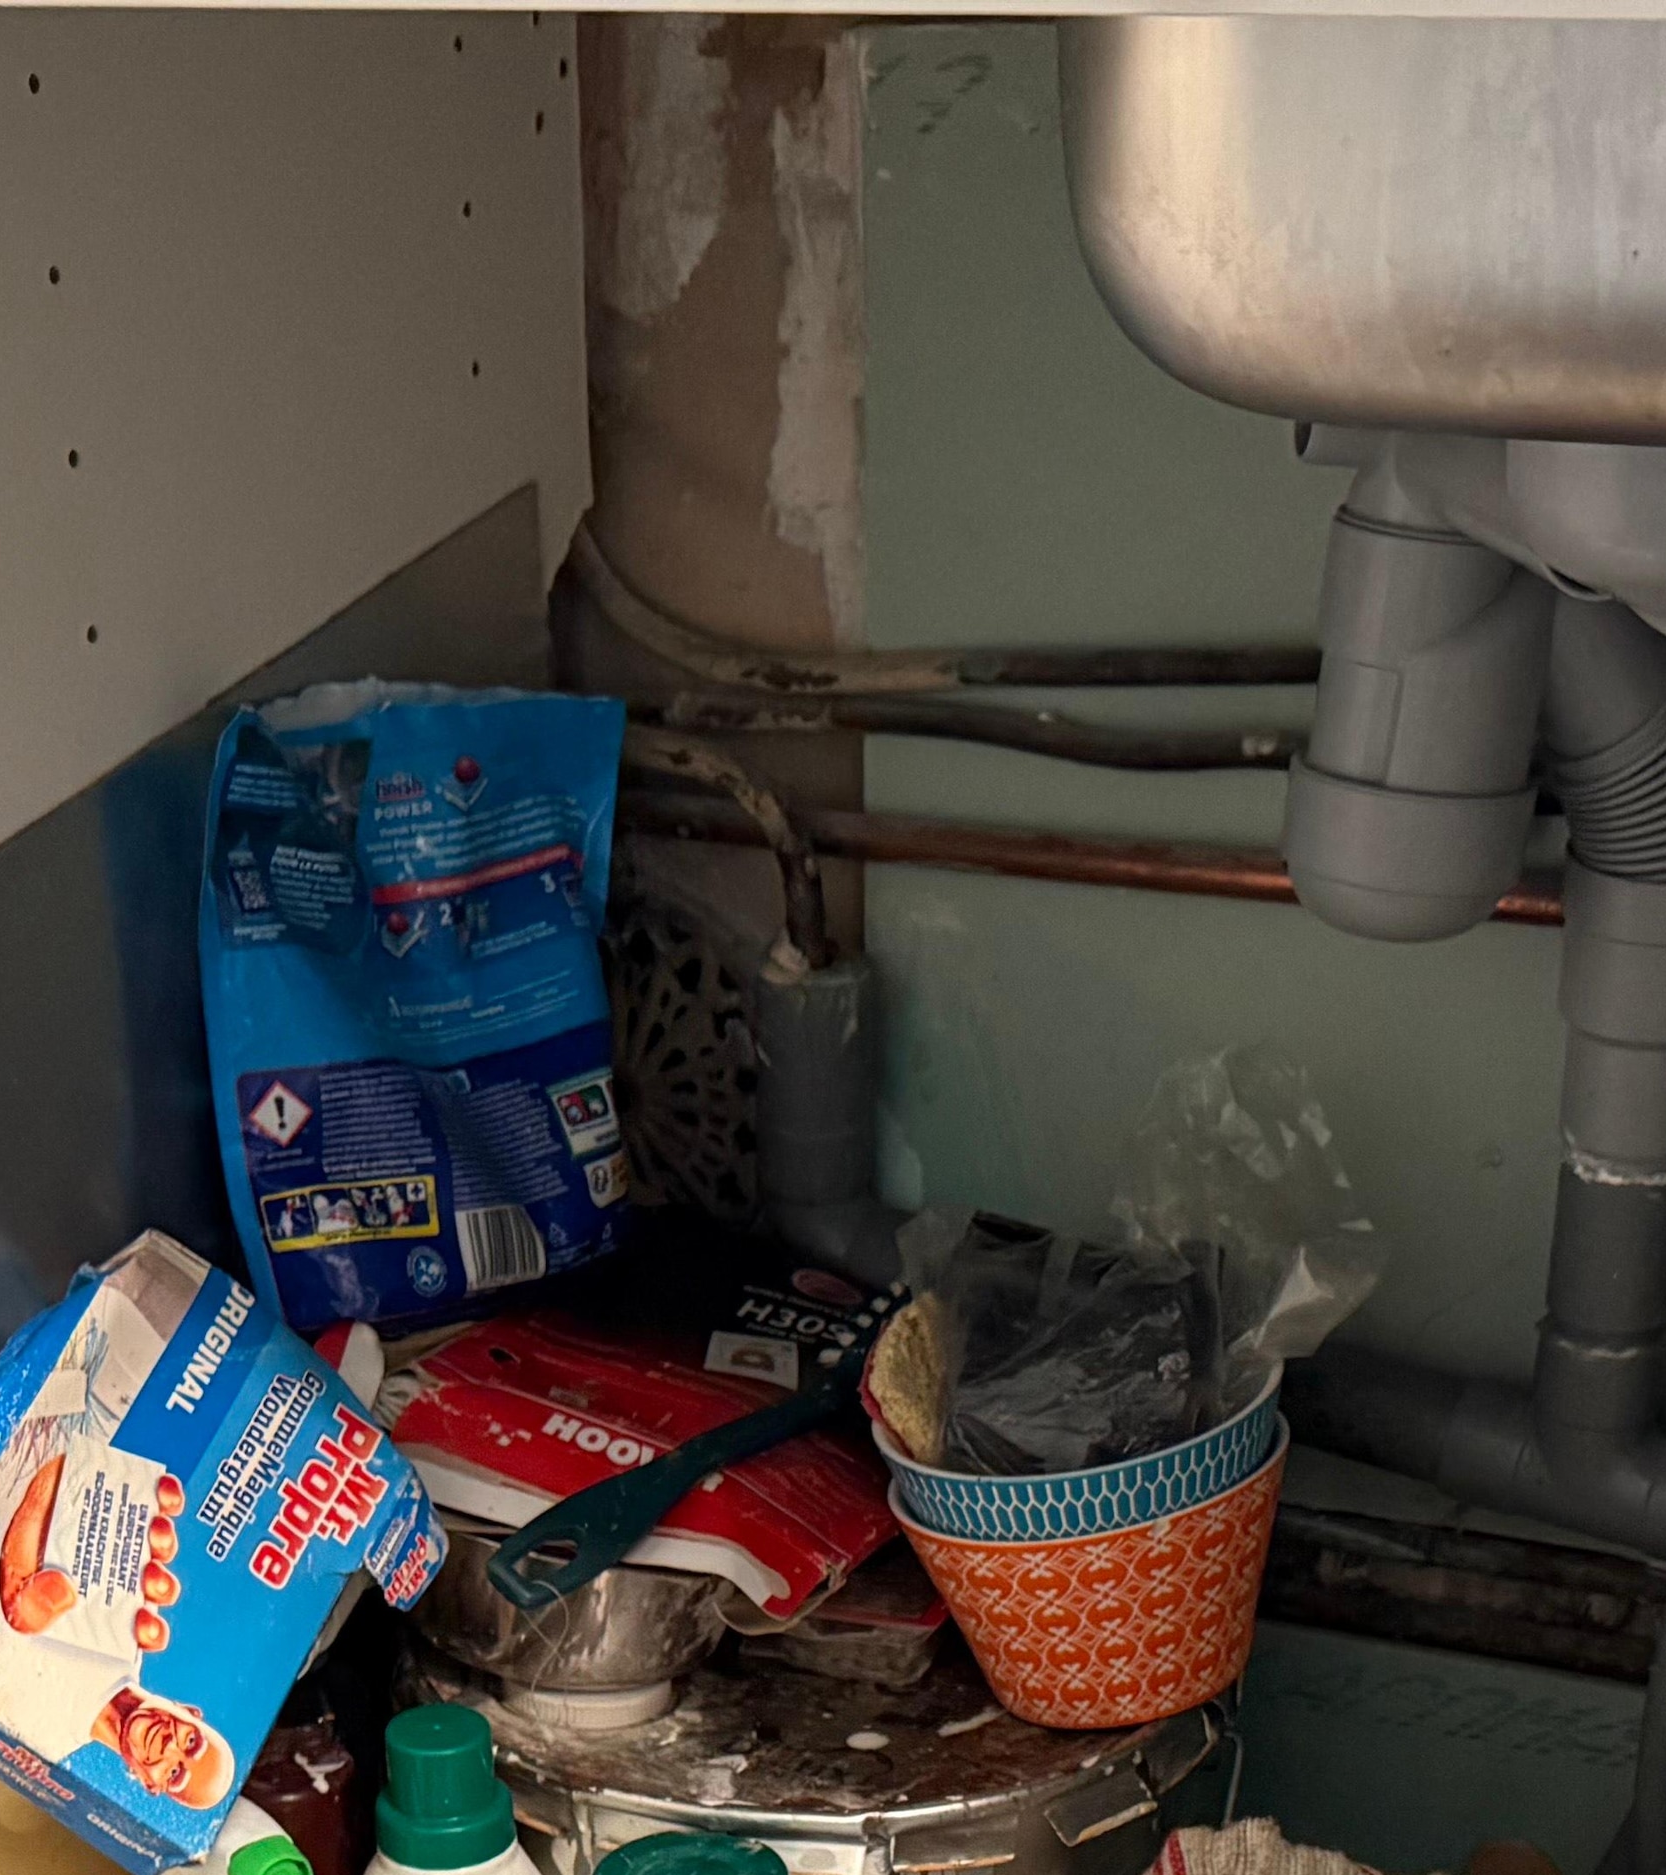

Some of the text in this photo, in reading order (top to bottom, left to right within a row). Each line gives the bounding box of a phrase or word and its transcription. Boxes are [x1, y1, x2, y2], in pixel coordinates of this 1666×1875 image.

[197, 1372, 299, 1526] Wondergum
[206, 1369, 325, 1562] GommeMagique
[248, 1402, 384, 1589] Propre
[91, 1515, 109, 1587] KRACHTIGE
[116, 1502, 137, 1590] SURPUISSANT
[127, 1503, 148, 1596] UN NETTOYAGE
[316, 1463, 389, 1546] Mr.
